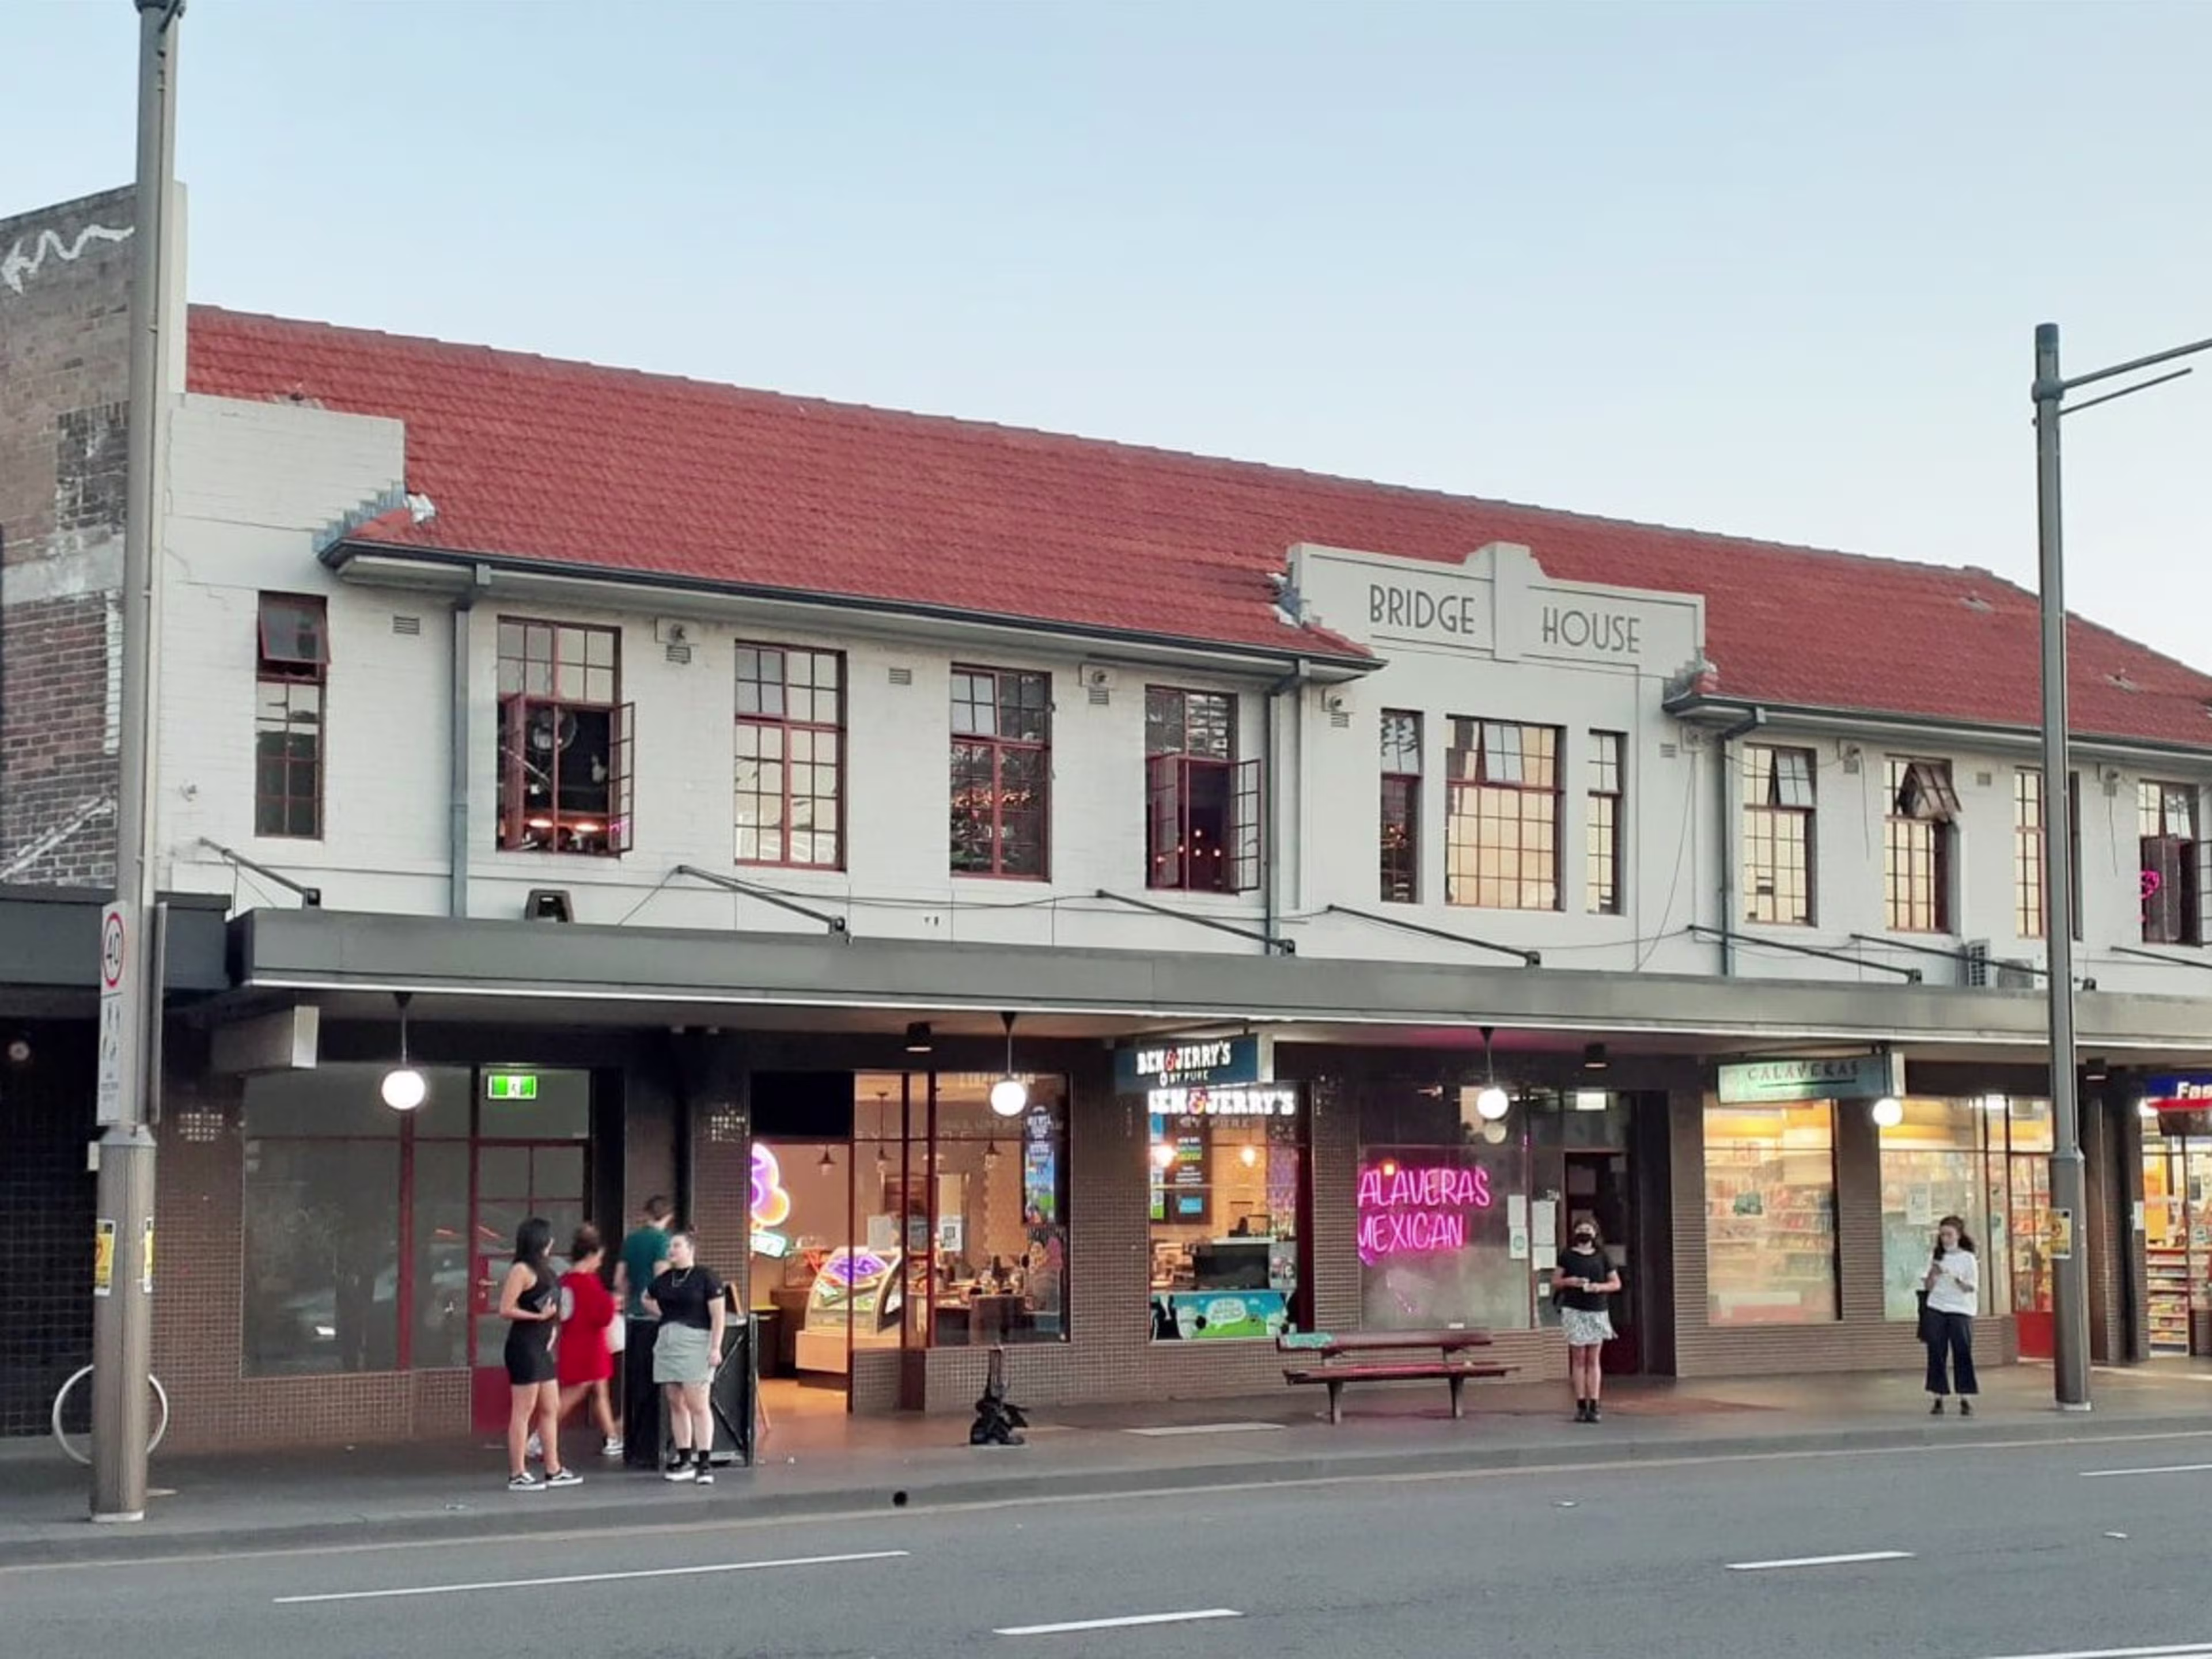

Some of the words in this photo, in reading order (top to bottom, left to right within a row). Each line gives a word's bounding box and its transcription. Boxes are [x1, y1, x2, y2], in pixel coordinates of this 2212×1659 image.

[1370, 584, 1475, 634] BRIDGE
[1543, 606, 1641, 654] HOUSE
[105, 932, 121, 967] 40
[1748, 1060, 1859, 1081] CALAVERAS
